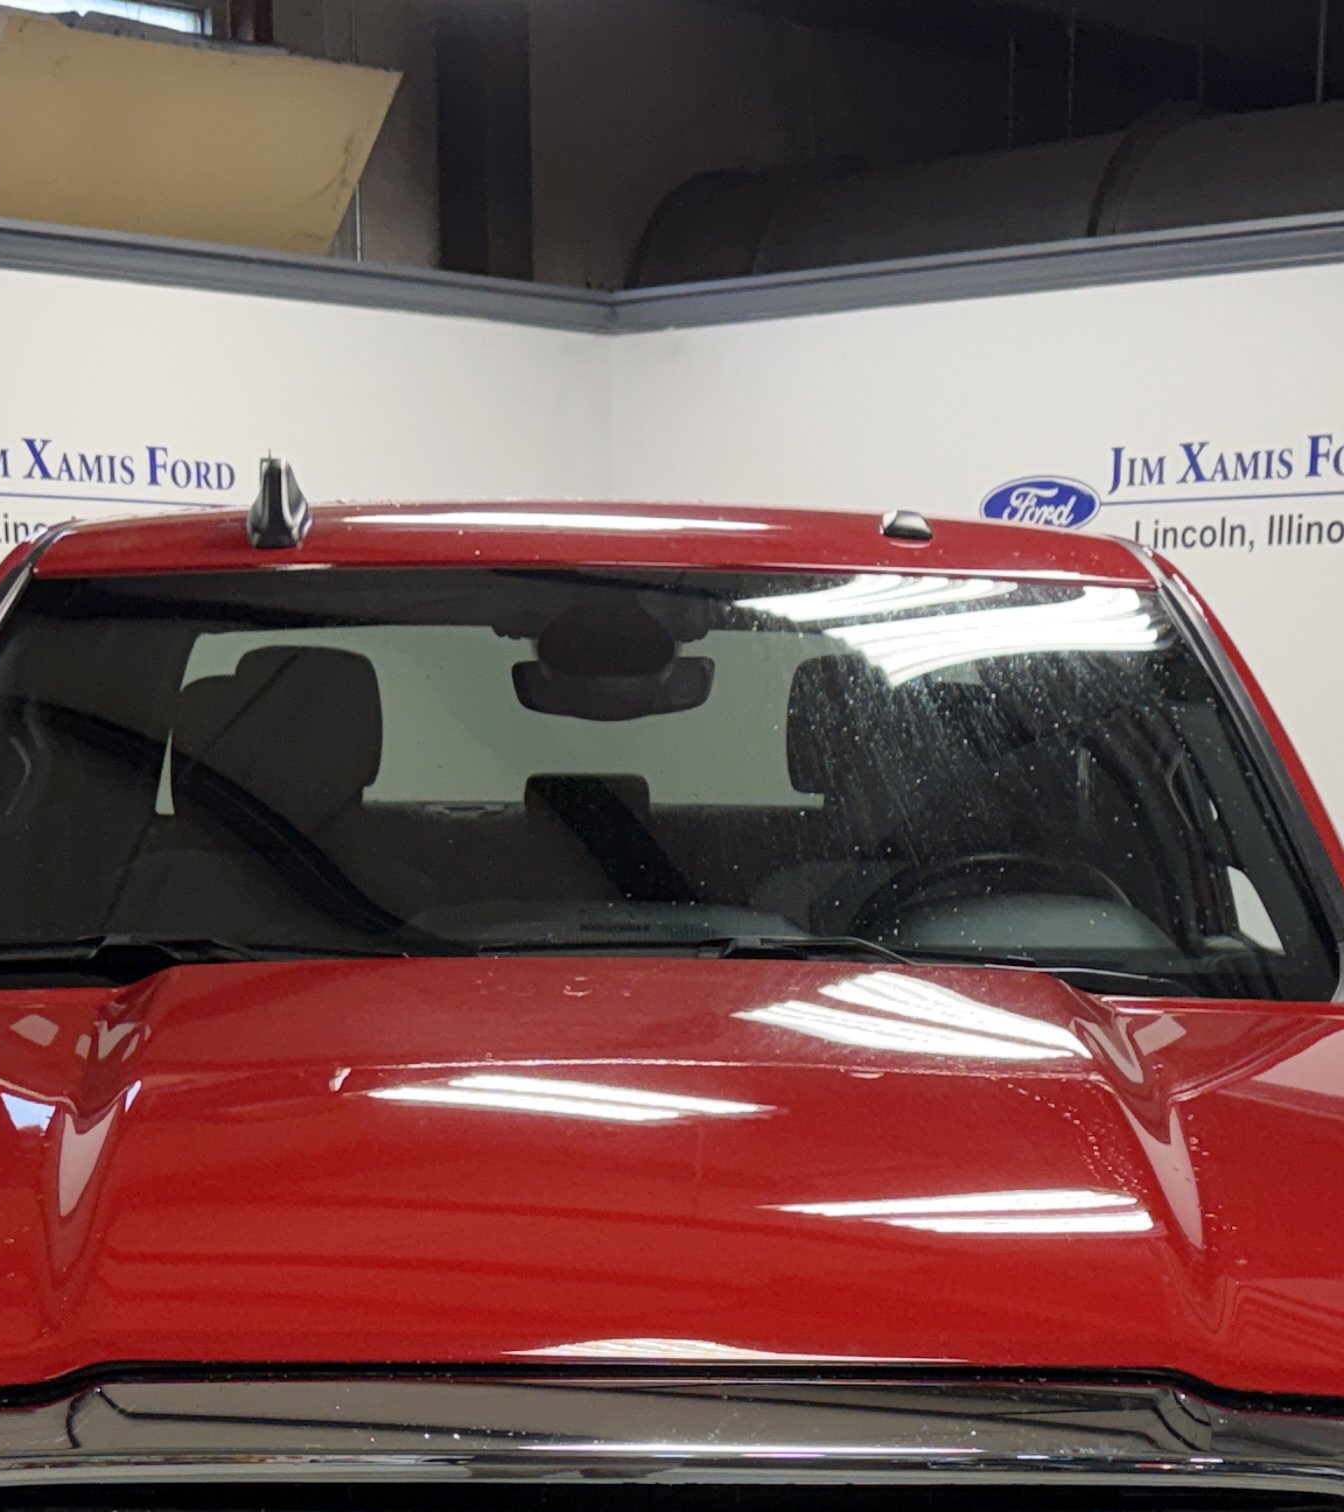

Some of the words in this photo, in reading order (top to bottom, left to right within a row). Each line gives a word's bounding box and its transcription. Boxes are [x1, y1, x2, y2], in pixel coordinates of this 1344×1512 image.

[20, 437, 136, 486] XAMIS
[145, 445, 236, 491] FORD
[1107, 446, 1166, 495] JIM
[1176, 440, 1294, 485] XAMIS
[1002, 486, 1077, 527] Ford
